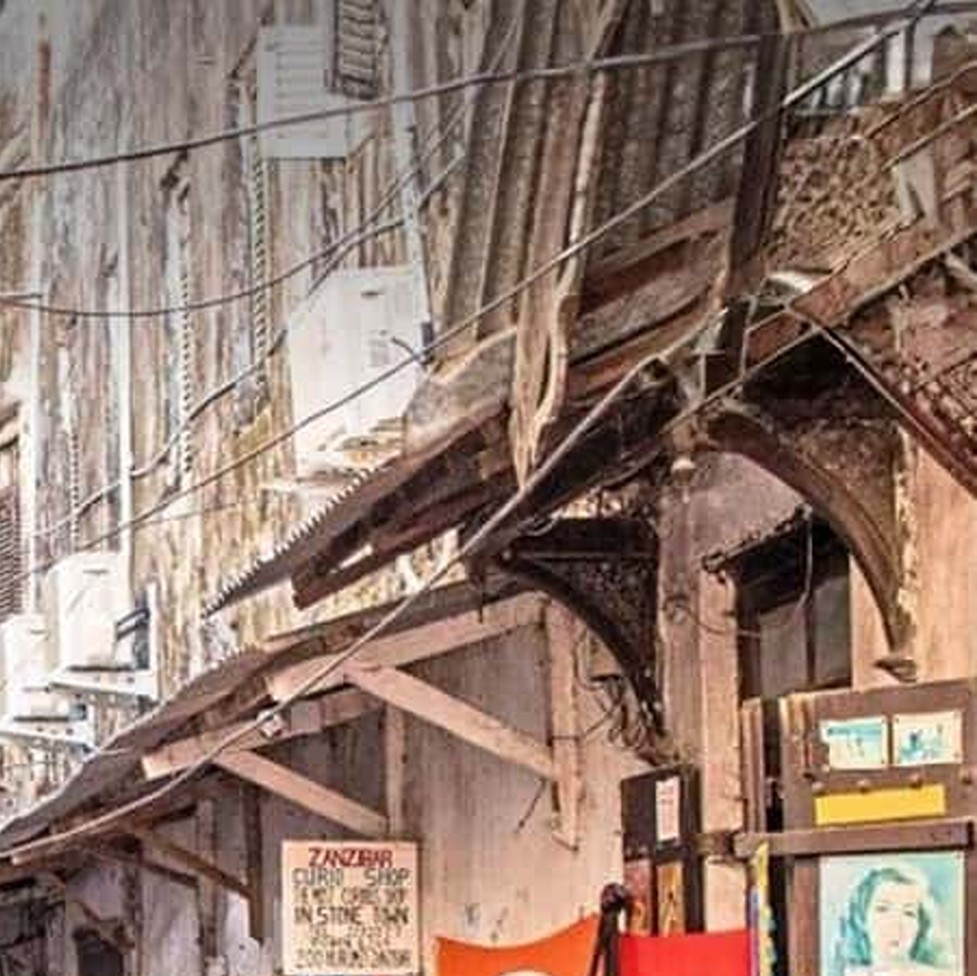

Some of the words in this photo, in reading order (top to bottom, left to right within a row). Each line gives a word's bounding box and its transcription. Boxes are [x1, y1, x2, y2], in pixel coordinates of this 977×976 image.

[308, 847, 393, 868] ZANZIBAR
[292, 867, 344, 886] CURIO
[363, 867, 411, 886] SHOP
